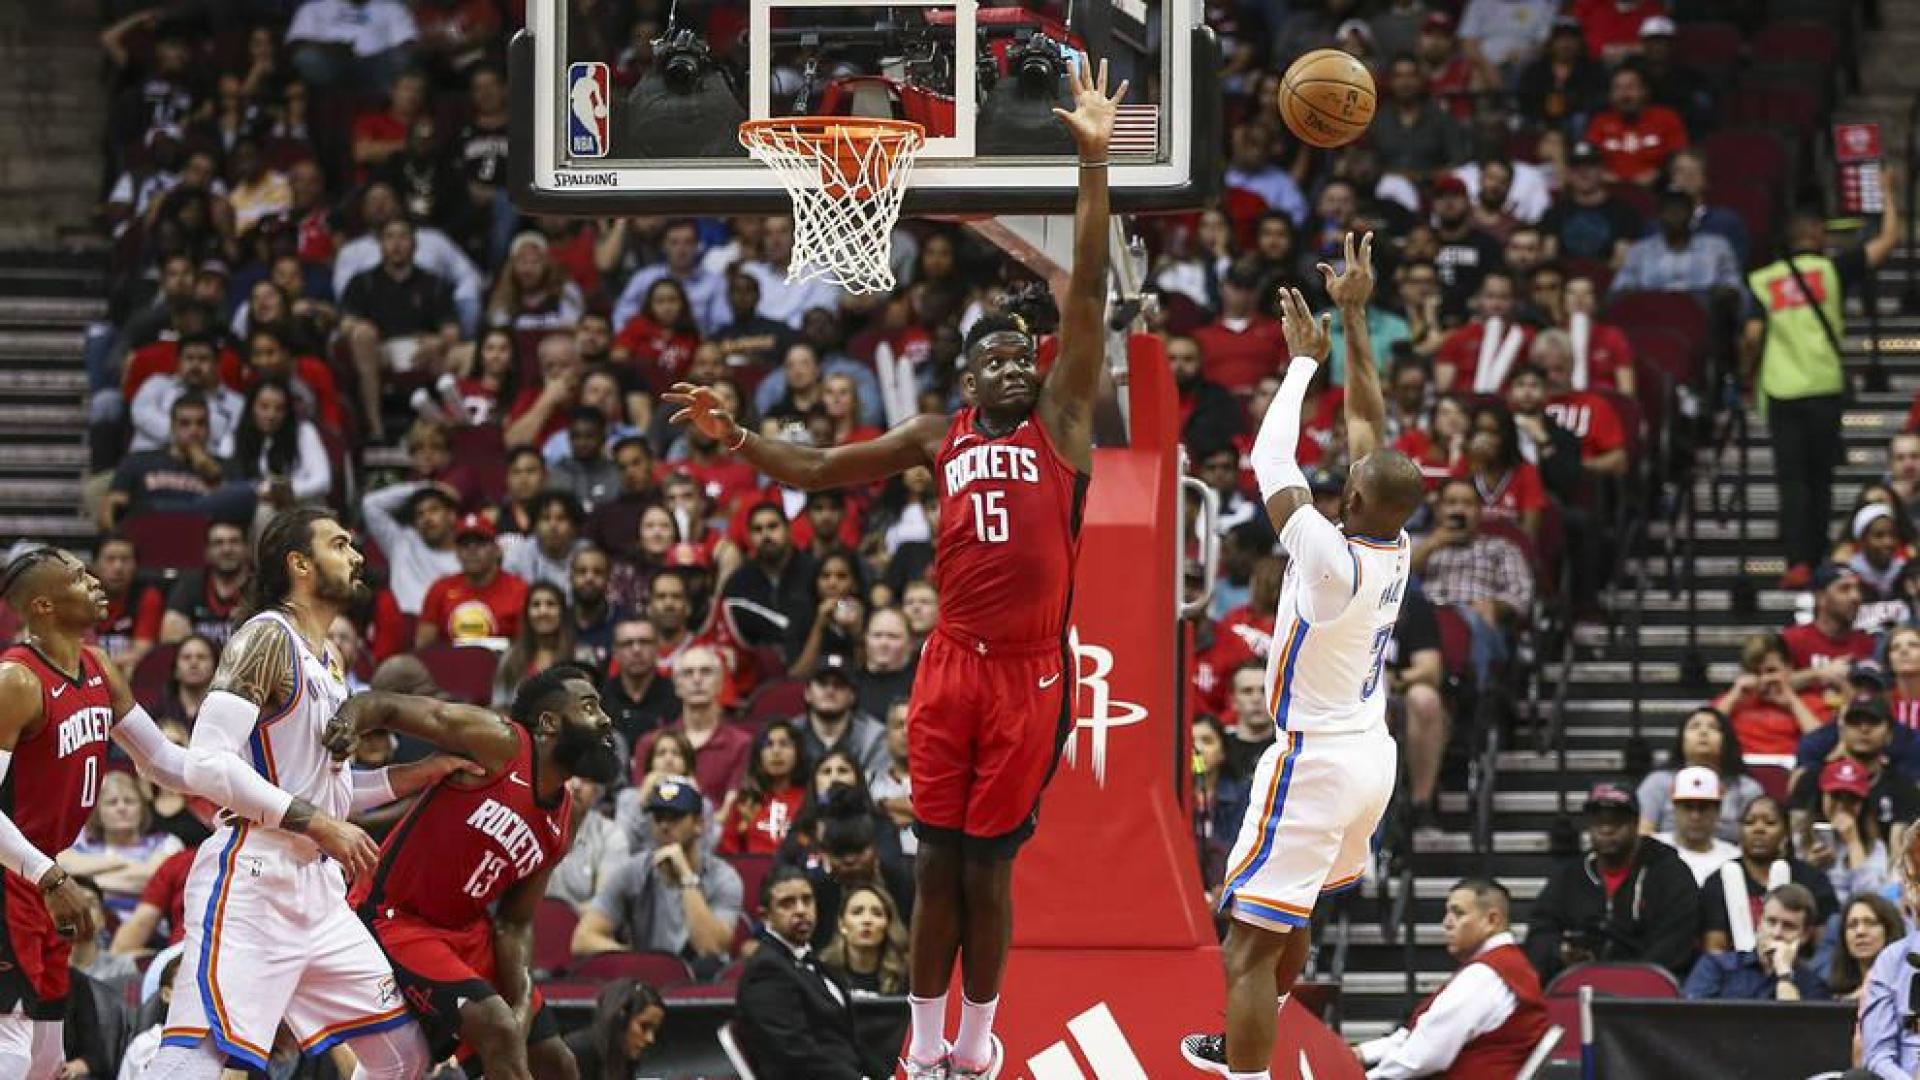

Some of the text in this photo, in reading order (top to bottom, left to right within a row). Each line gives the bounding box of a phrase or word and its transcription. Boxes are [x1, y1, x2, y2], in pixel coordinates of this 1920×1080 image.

[573, 136, 594, 151] NBA
[554, 173, 618, 187] SPALDING
[944, 445, 1039, 497] ROCKETS
[971, 490, 1009, 542] 15
[1360, 627, 1392, 701] 3
[58, 706, 113, 759] ROCKET
[81, 755, 97, 808] 0
[466, 798, 544, 879] ROCKETS
[463, 849, 508, 898] 13
